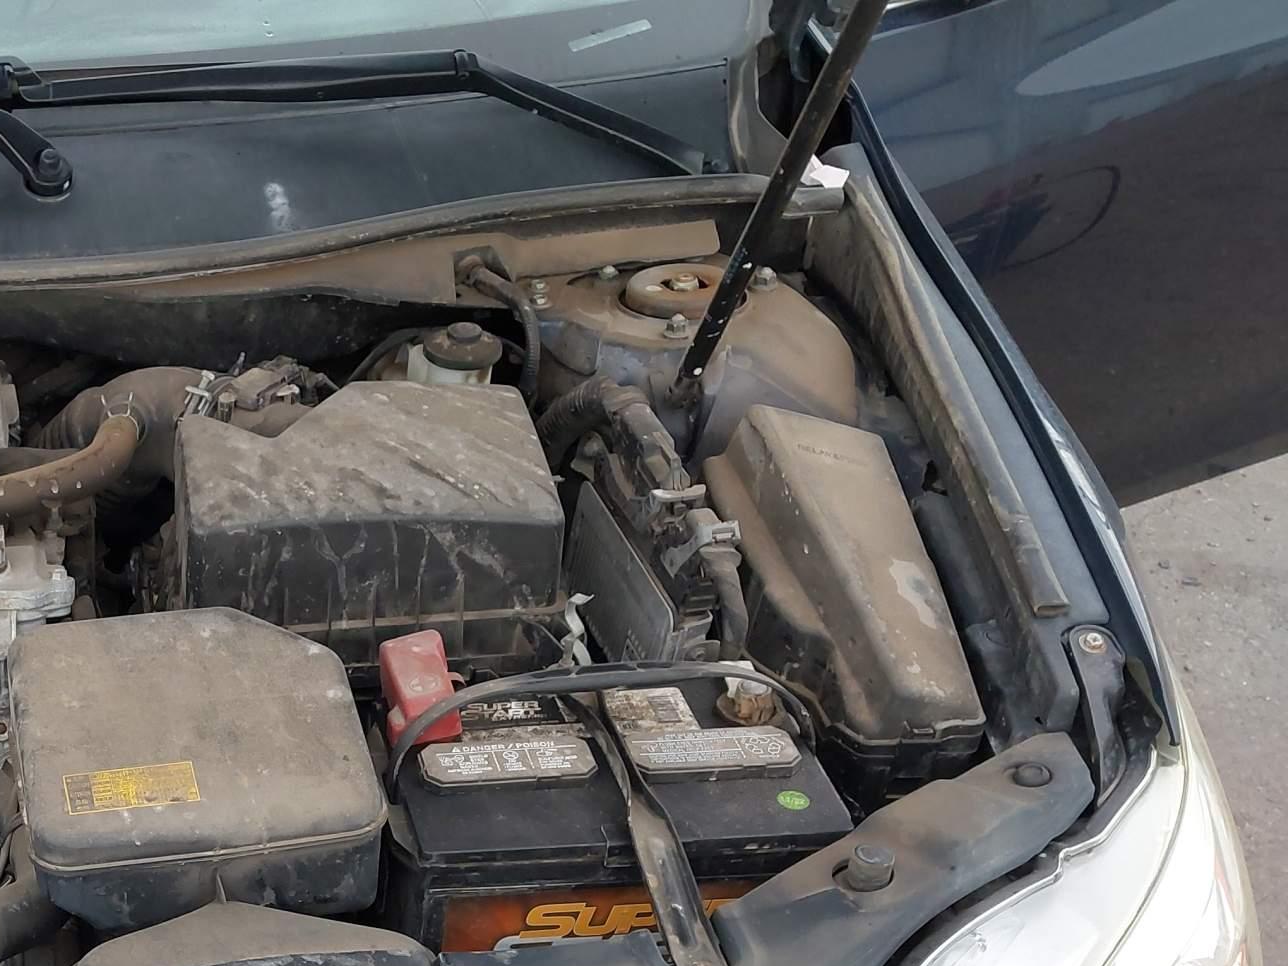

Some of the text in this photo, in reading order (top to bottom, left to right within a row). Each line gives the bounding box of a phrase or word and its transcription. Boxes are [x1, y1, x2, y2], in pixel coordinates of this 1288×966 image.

[467, 700, 541, 712] SUPER
[462, 744, 505, 752] DANGER
[515, 741, 555, 749] POISON
